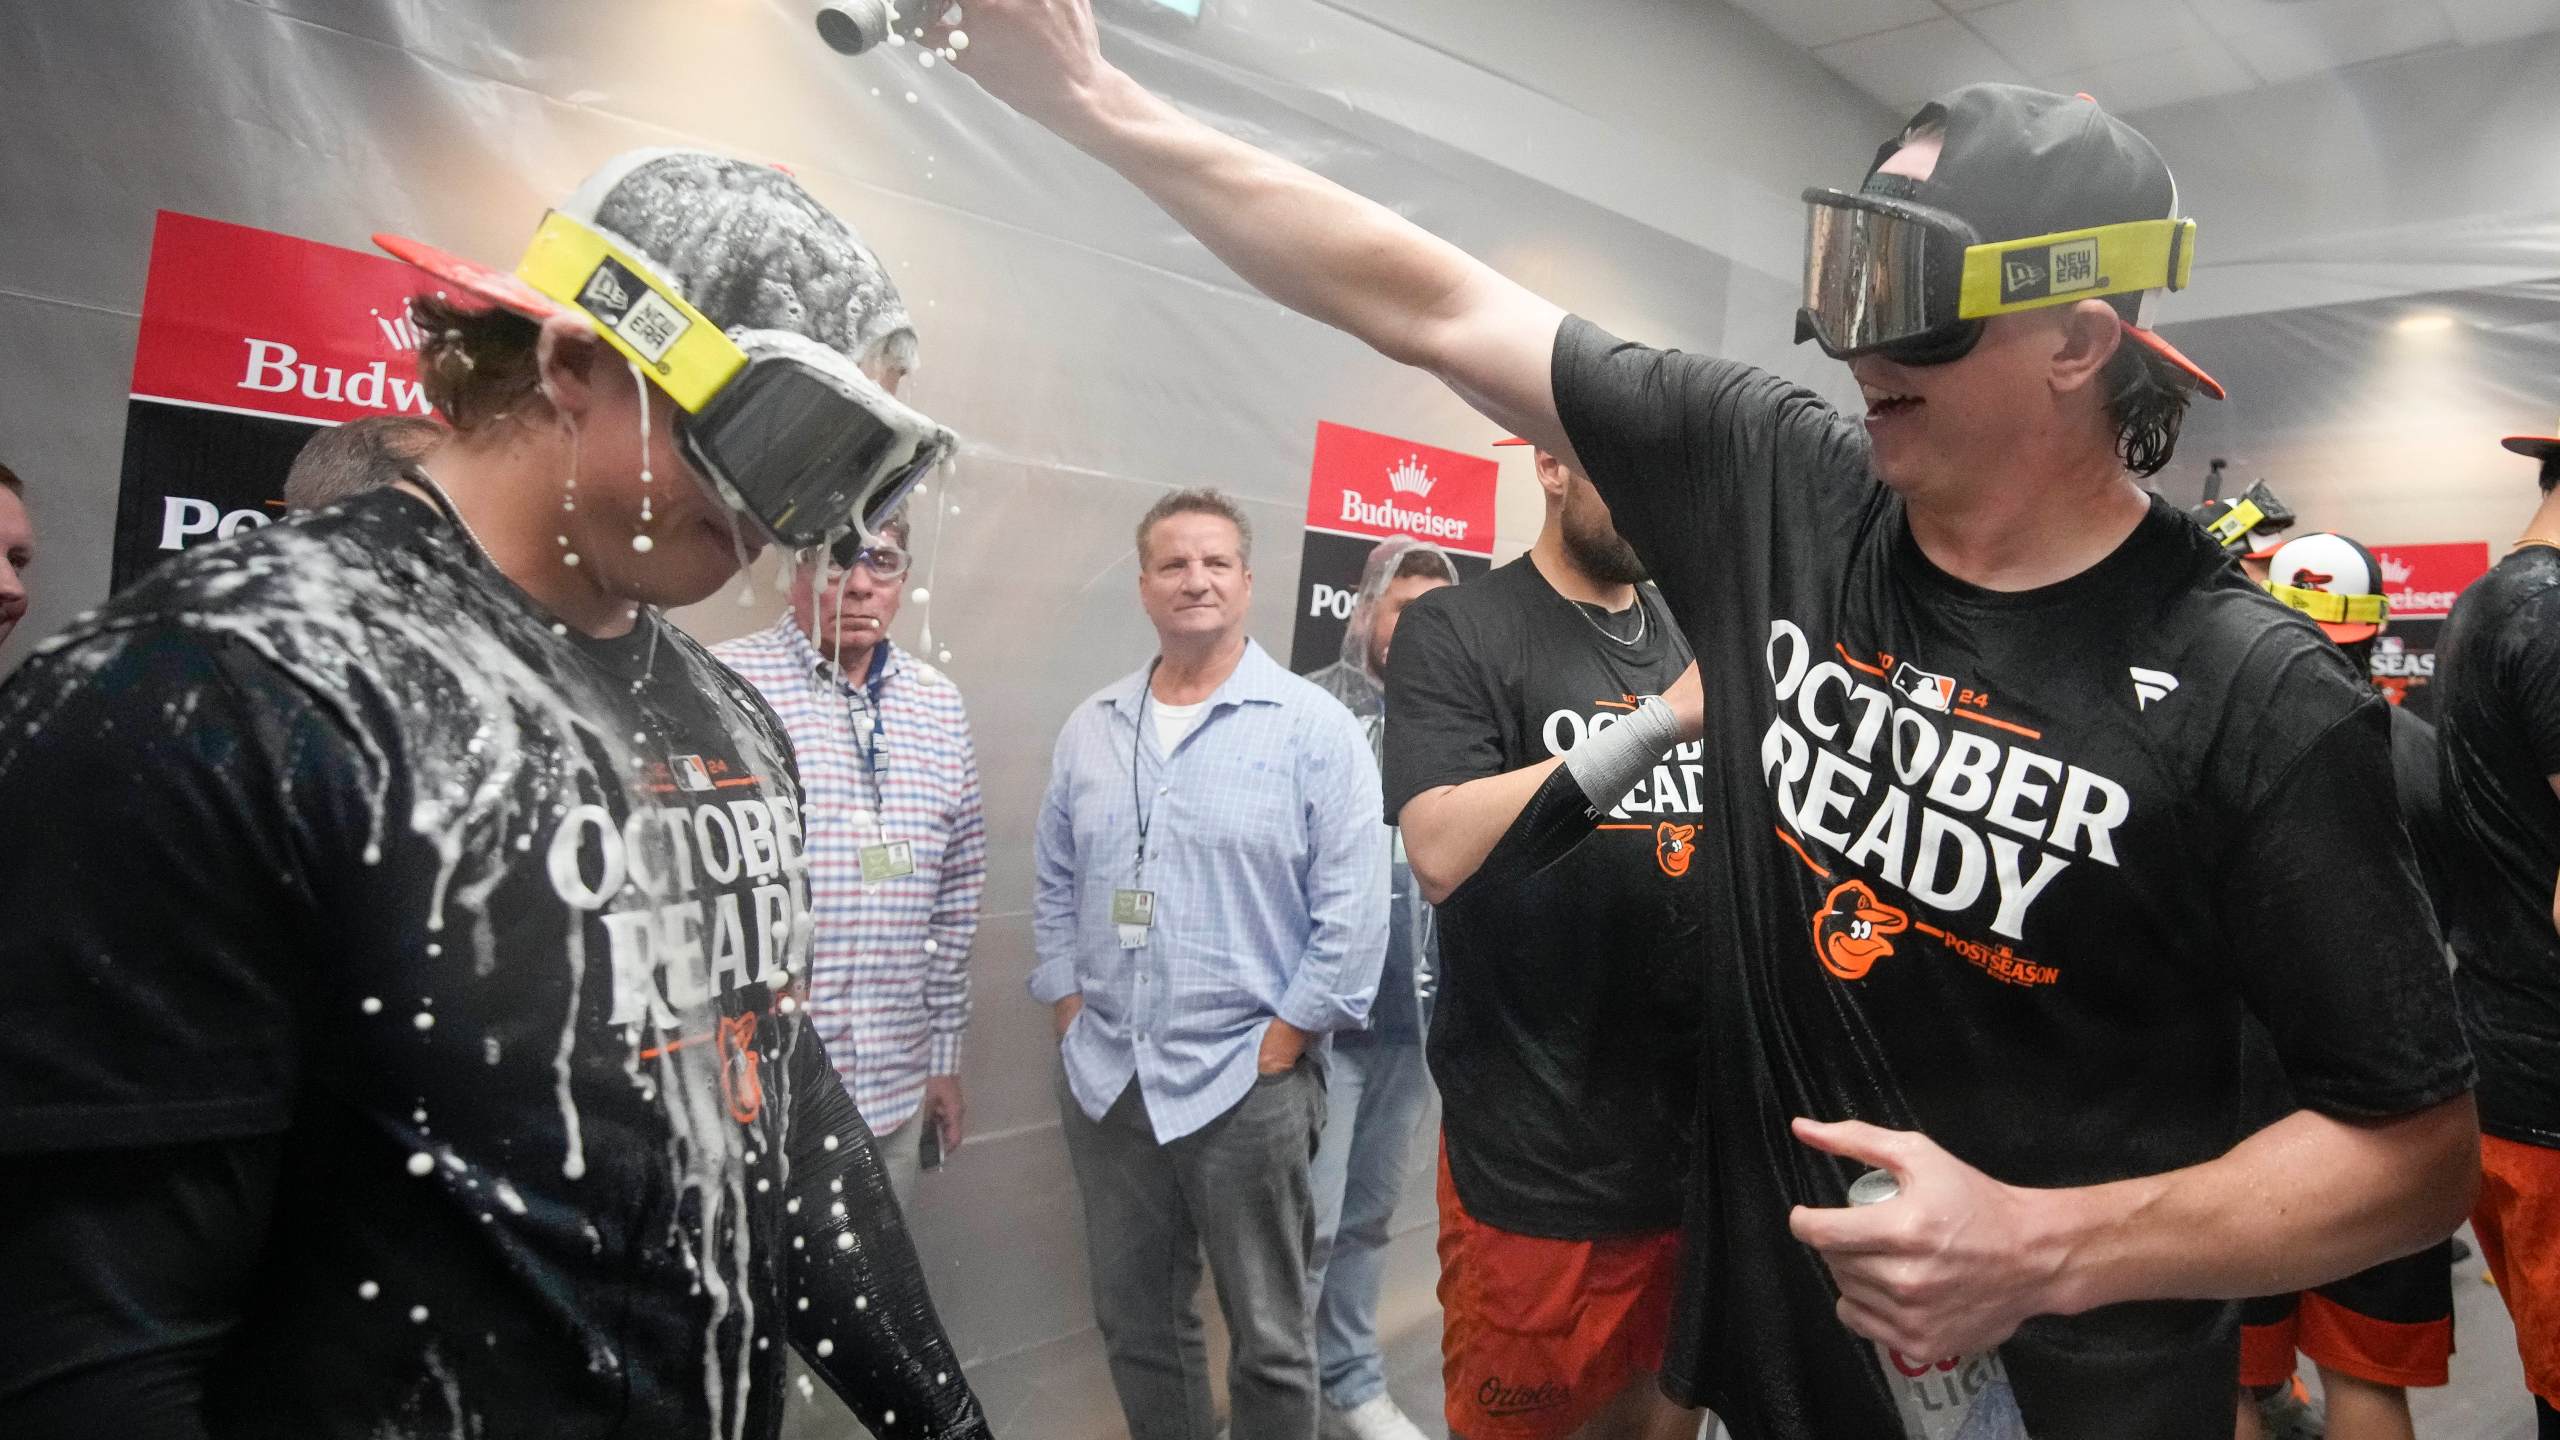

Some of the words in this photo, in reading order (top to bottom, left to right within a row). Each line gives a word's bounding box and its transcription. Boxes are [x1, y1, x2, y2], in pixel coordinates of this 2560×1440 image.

[2056, 250, 2090, 267] NEW
[2056, 264, 2090, 283] ERA
[629, 316, 666, 350] ERA
[237, 338, 433, 415] Budw
[1340, 489, 1468, 541] Budweiser
[1958, 689, 1989, 709] 24
[1766, 619, 2130, 867] OCTOBER
[1761, 712, 2072, 940] READY
[547, 796, 809, 910] OCTOBE
[600, 883, 812, 1030] READ
[1945, 931, 2061, 984] POSTSEASON
